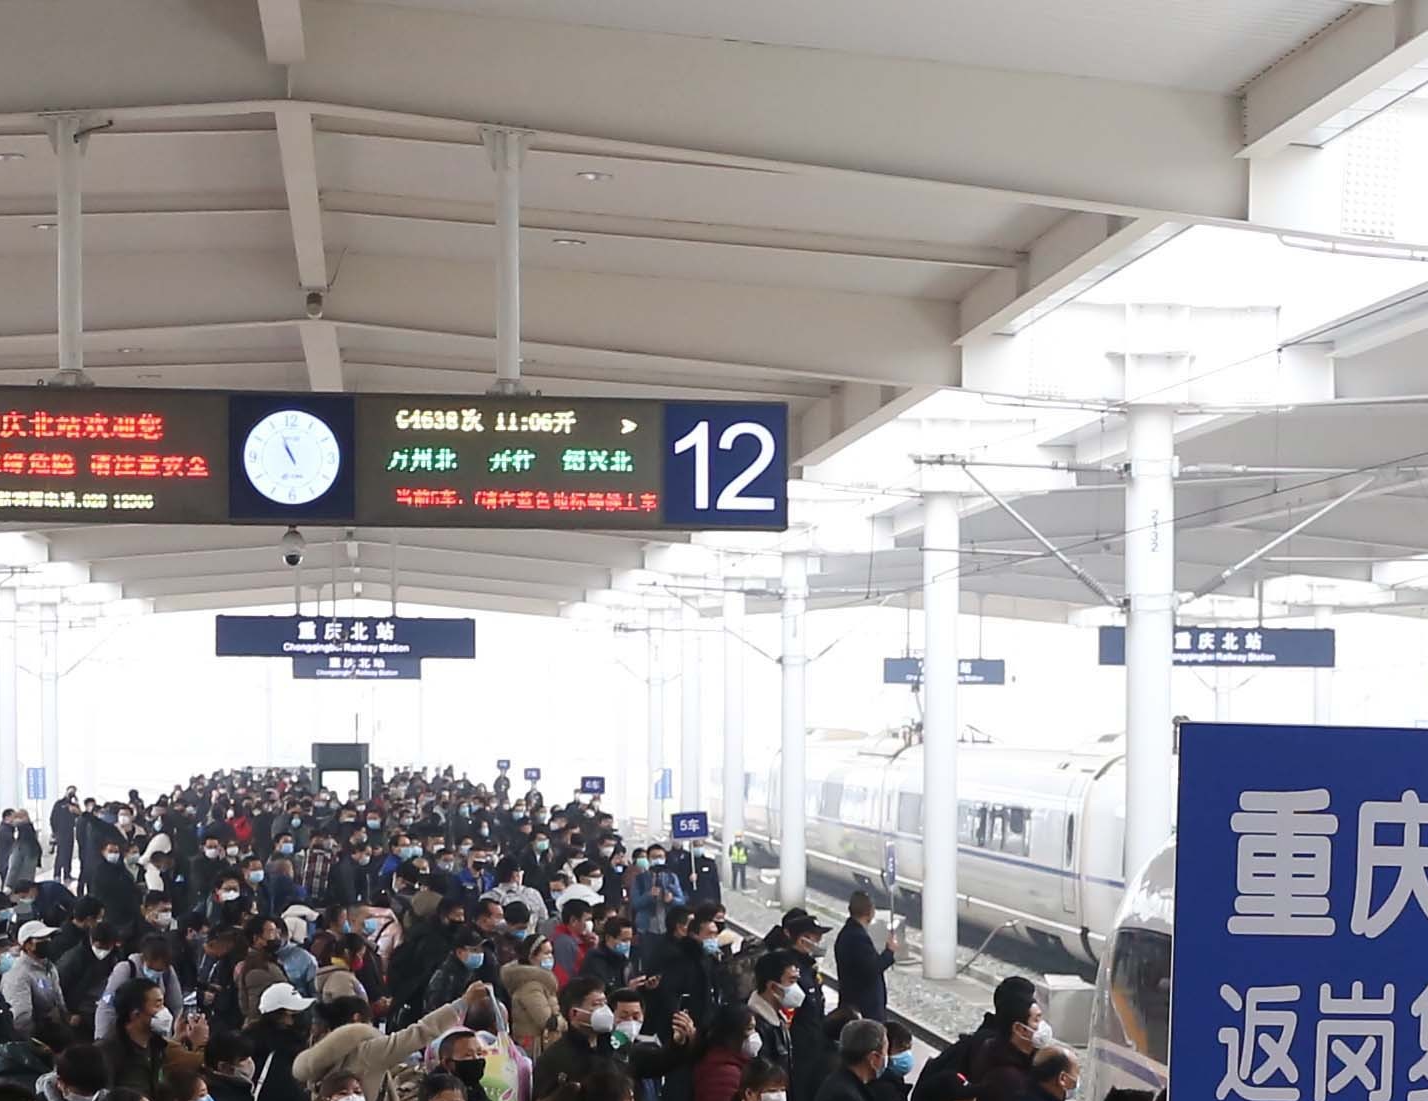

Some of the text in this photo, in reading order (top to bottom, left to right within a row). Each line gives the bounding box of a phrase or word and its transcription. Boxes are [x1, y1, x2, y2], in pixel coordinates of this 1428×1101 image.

[285, 415, 298, 427] 12
[562, 449, 633, 472] 绍兴北
[673, 421, 775, 510] 12
[298, 621, 395, 641] 重庆北站
[1174, 632, 1263, 650] 重庆北站
[679, 817, 701, 831] 5车
